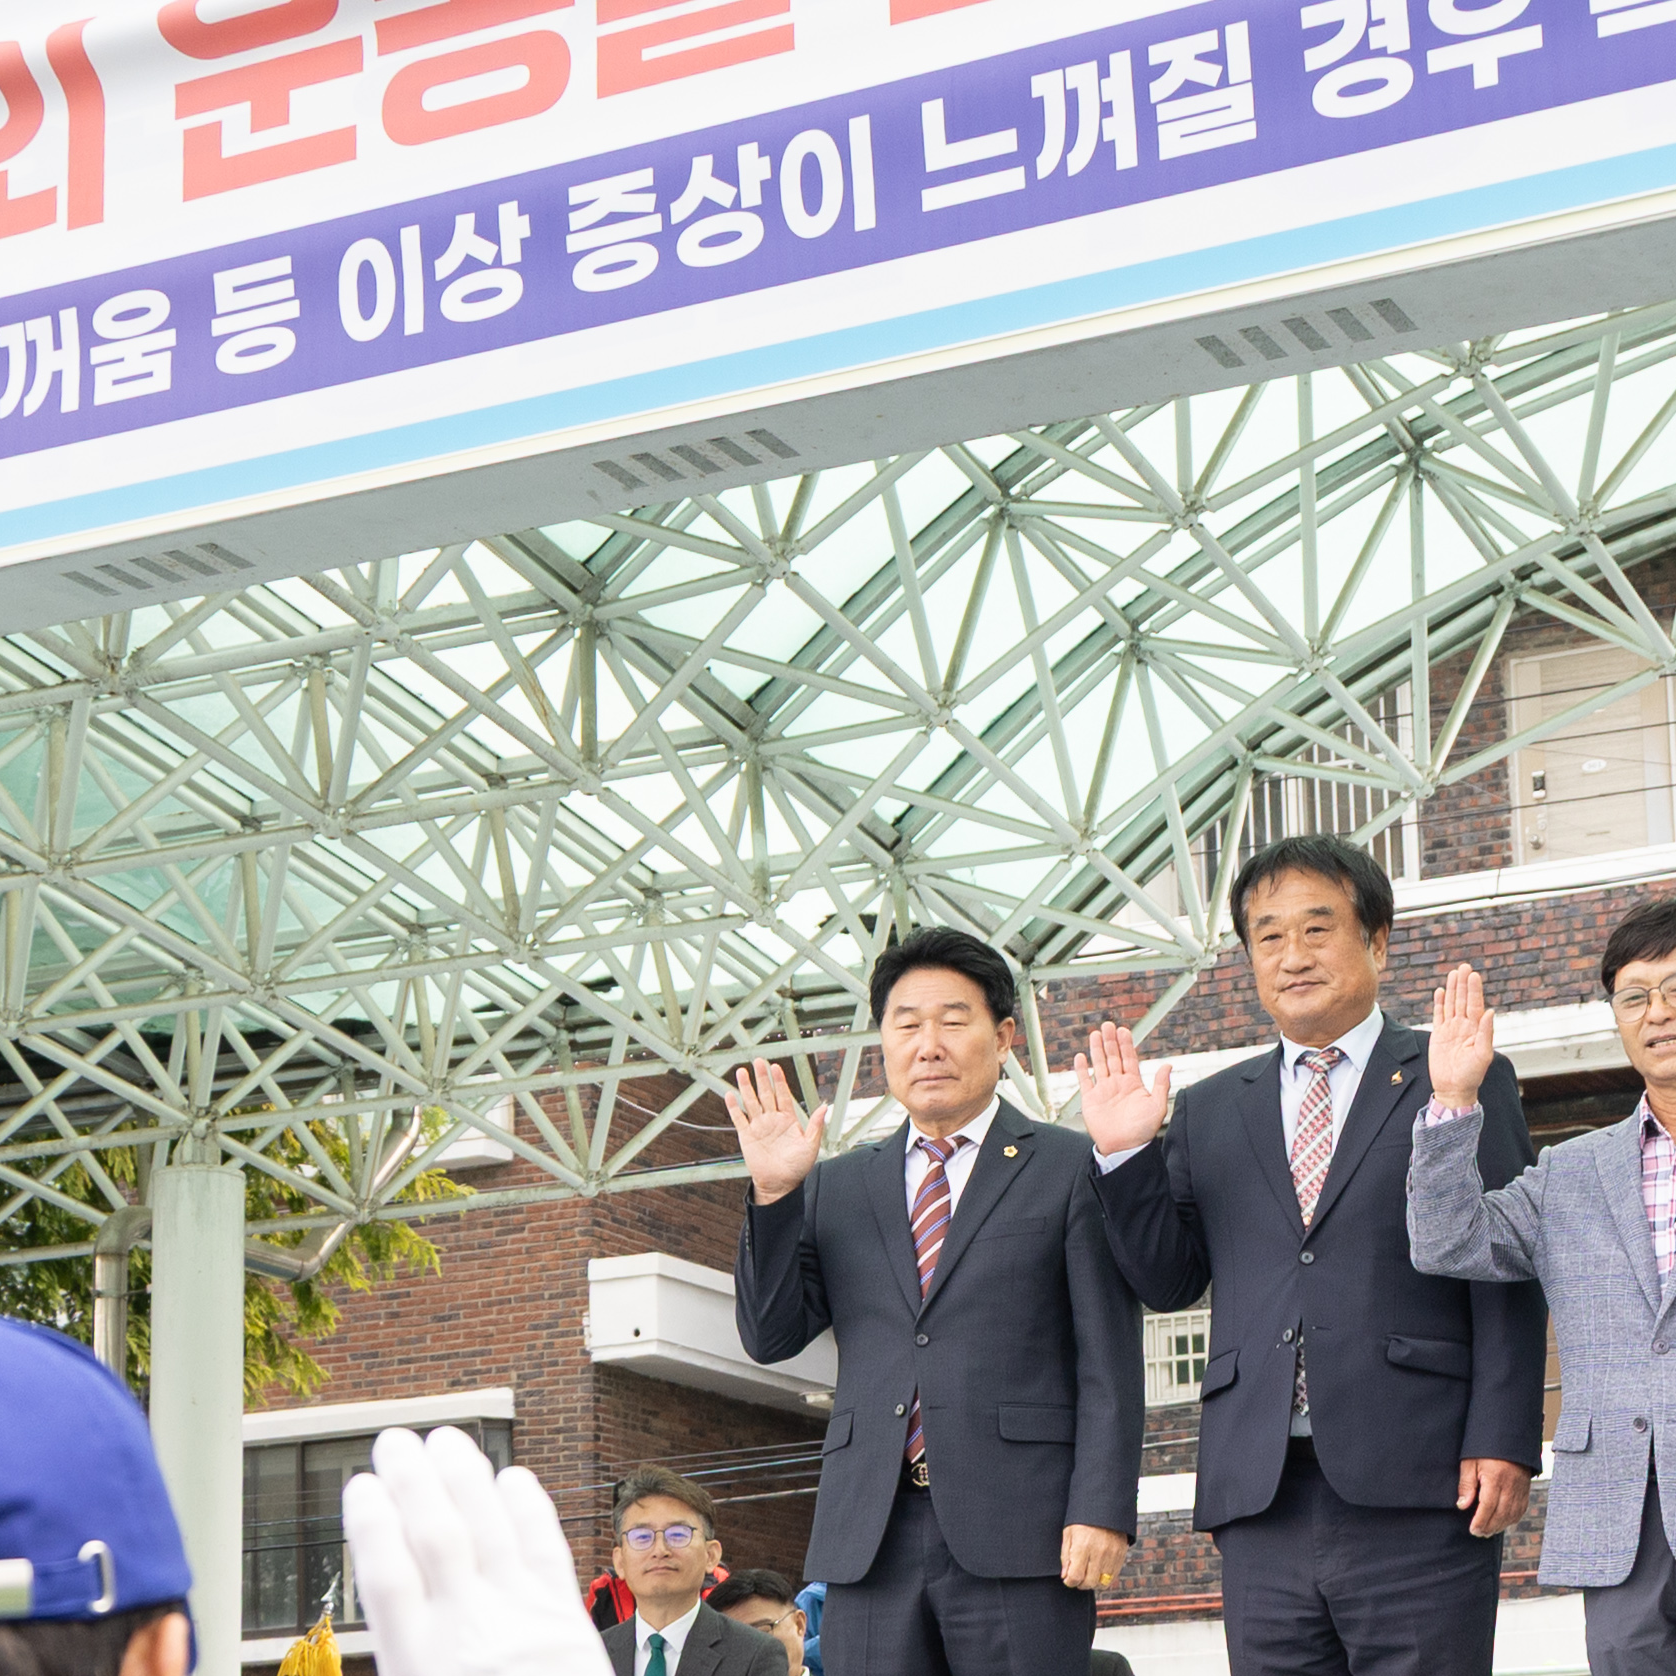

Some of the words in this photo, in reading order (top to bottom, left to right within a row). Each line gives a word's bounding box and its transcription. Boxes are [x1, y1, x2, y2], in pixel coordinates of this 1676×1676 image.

[212, 256, 300, 375] 등
[339, 201, 531, 342] 이상
[567, 115, 876, 292] 증상이
[922, 21, 1258, 212] 느껴질
[1301, 0, 1543, 120] 경우
